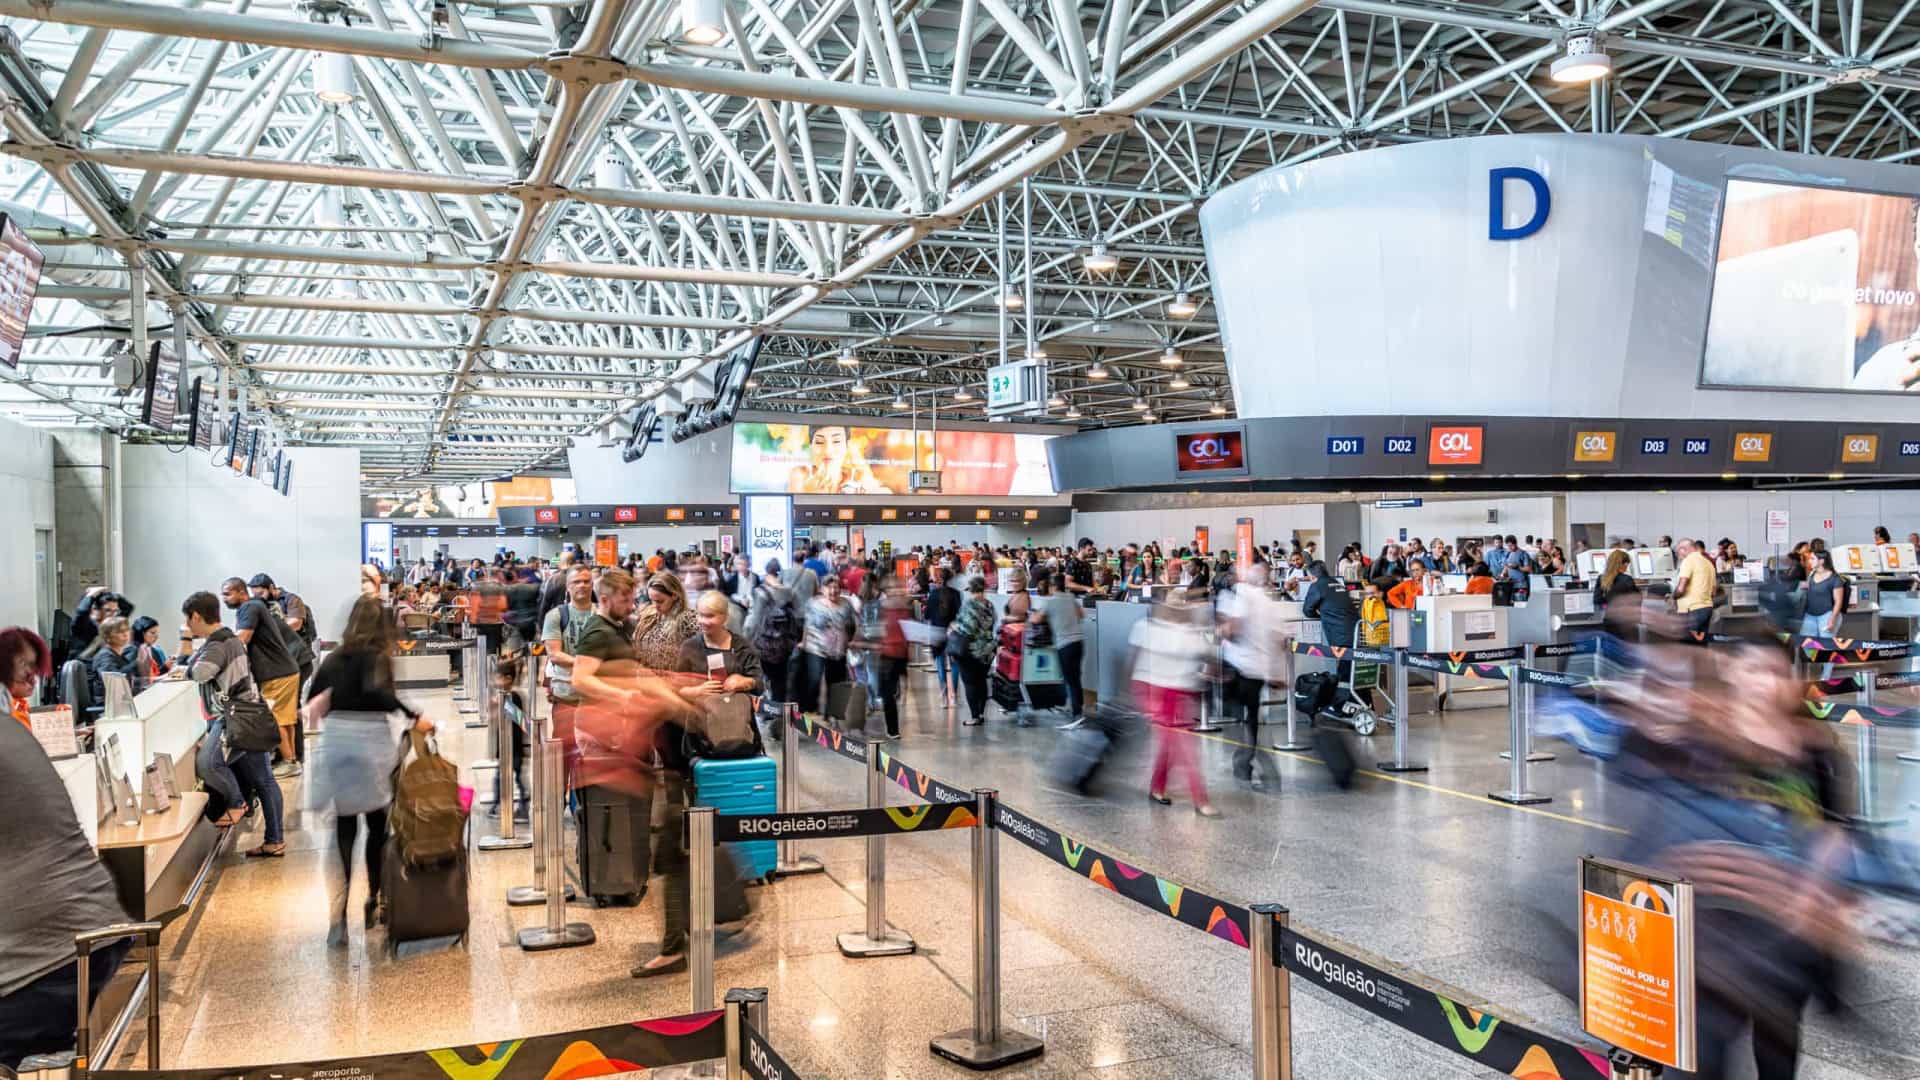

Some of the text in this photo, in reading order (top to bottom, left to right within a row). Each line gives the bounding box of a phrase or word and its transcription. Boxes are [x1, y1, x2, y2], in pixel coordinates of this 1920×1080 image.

[1489, 167, 1551, 240] D
[1874, 288, 1915, 304] novo
[1188, 438, 1231, 457] GOL
[1332, 440, 1357, 452] D01
[1388, 440, 1411, 452] D02
[1439, 432, 1472, 451] GOL
[1582, 436, 1607, 450] GOL
[1644, 441, 1665, 452] D03
[1686, 441, 1706, 452] D04
[1740, 438, 1764, 451] GOL
[1848, 440, 1870, 452] GOL
[754, 527, 784, 538] Uber
[738, 815, 827, 837] RIOgaleão
[1001, 809, 1036, 841] RIOgaleão
[1295, 942, 1376, 997] RIOgaleão
[312, 1067, 361, 1078] aeroporto
